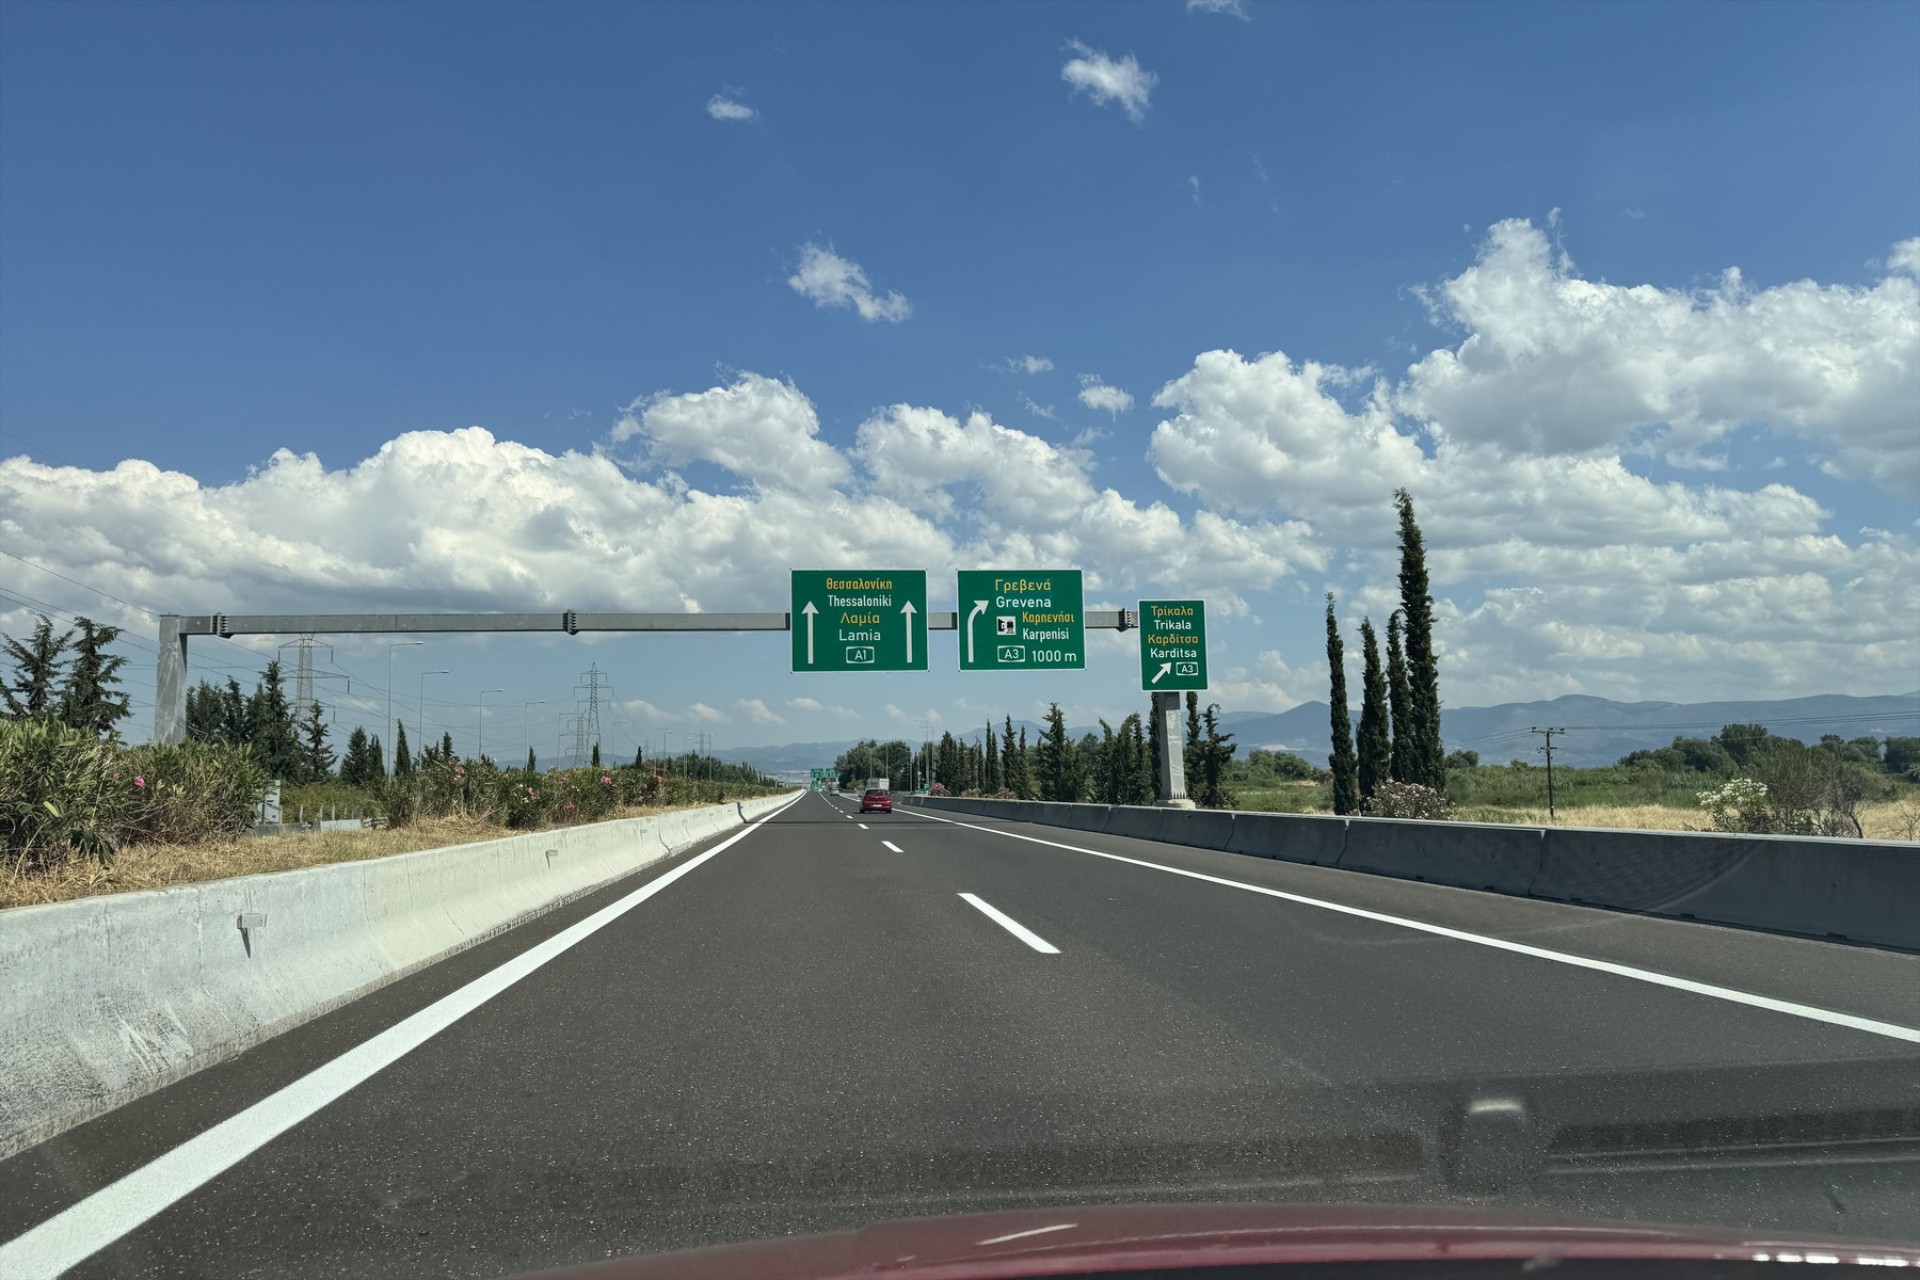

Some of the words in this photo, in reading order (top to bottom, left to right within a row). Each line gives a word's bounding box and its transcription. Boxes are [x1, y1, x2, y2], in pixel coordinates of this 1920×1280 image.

[826, 577, 893, 590] Θεσσαλονίκη
[995, 579, 1051, 594] Γρεβενά
[828, 595, 892, 607] Thessaloniki
[996, 596, 1052, 608] Grevena
[1151, 605, 1194, 618] Τρίκαλα
[840, 611, 880, 626] Λαμία
[1022, 611, 1075, 625] Καρπενήσι
[1154, 619, 1192, 630] Trikala
[839, 629, 881, 641] Lamia
[1023, 628, 1069, 642] Karpenisi
[1148, 634, 1199, 646] Καρδίτσα
[854, 650, 867, 660] A1
[1005, 649, 1019, 659] A3
[1032, 650, 1062, 662] 1000
[1064, 652, 1077, 662] m
[1150, 647, 1197, 658] Karditsa
[1181, 664, 1193, 674] A3
